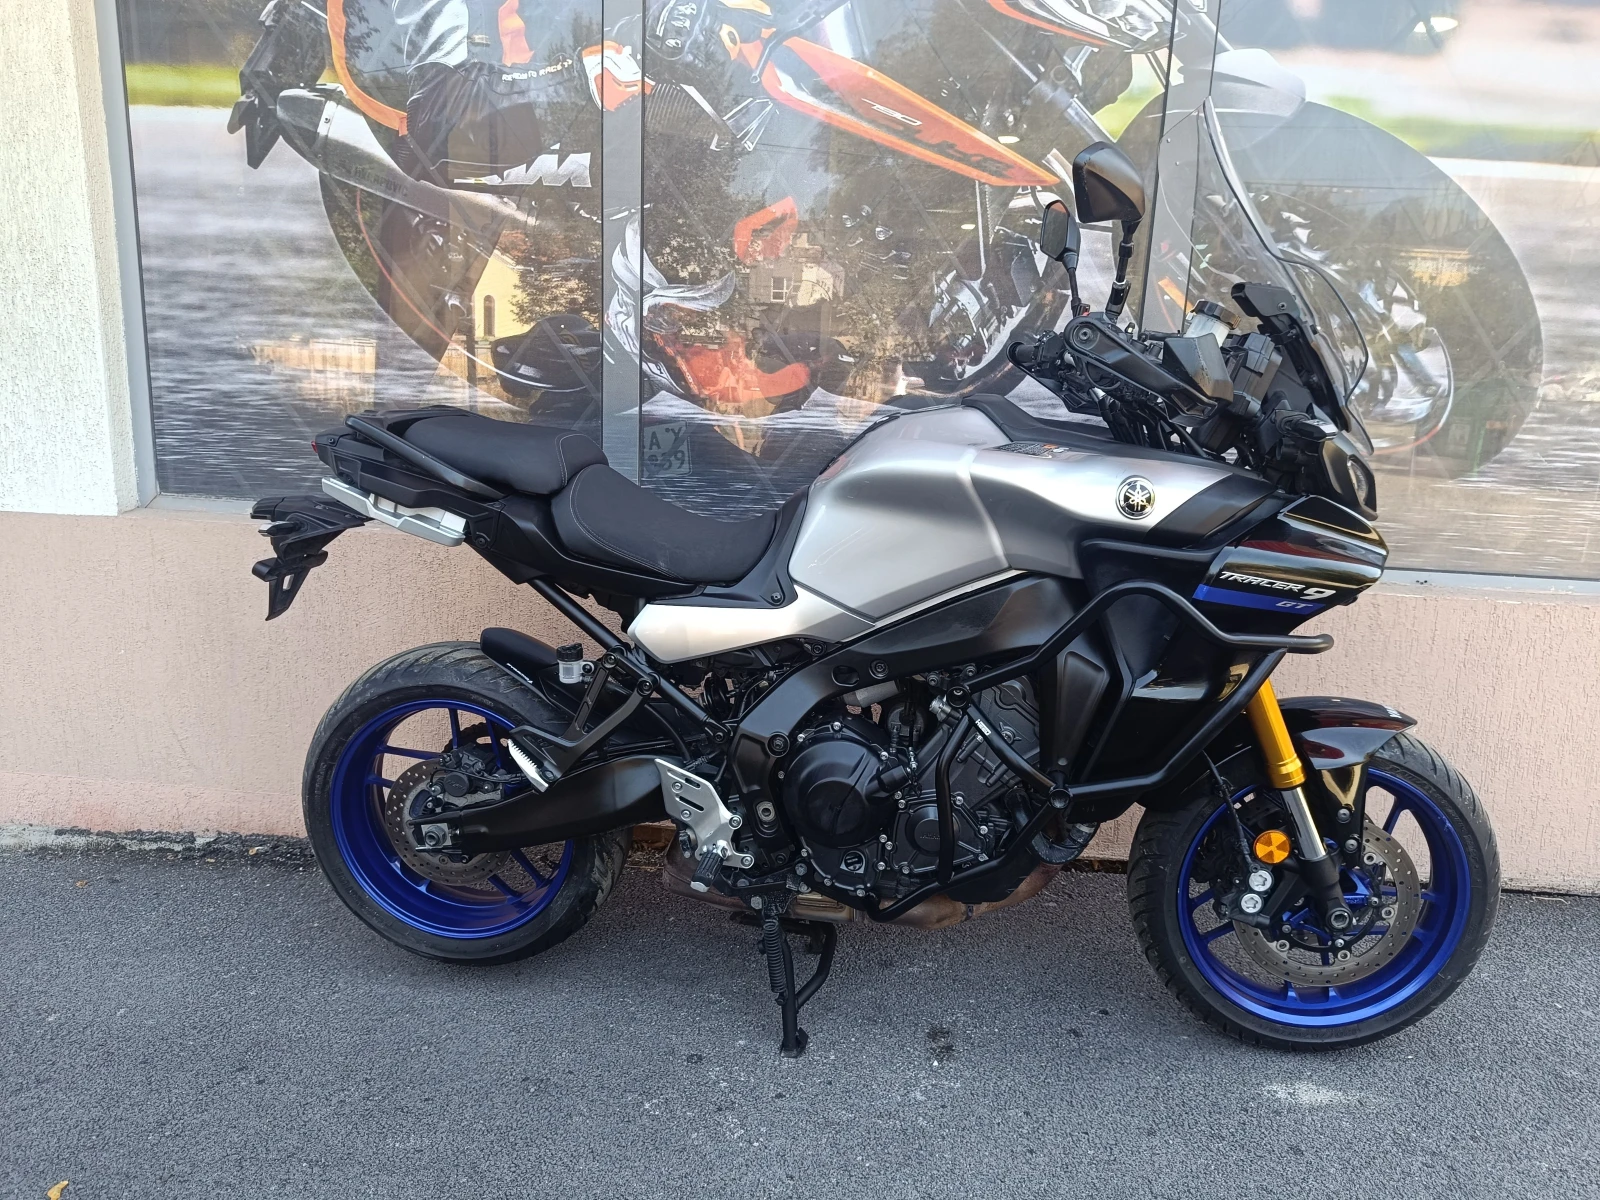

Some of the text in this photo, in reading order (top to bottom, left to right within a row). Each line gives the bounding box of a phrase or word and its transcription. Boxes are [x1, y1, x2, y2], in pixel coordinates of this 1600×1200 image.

[1219, 571, 1337, 600] TRACER 9
[1275, 601, 1313, 609] GT
